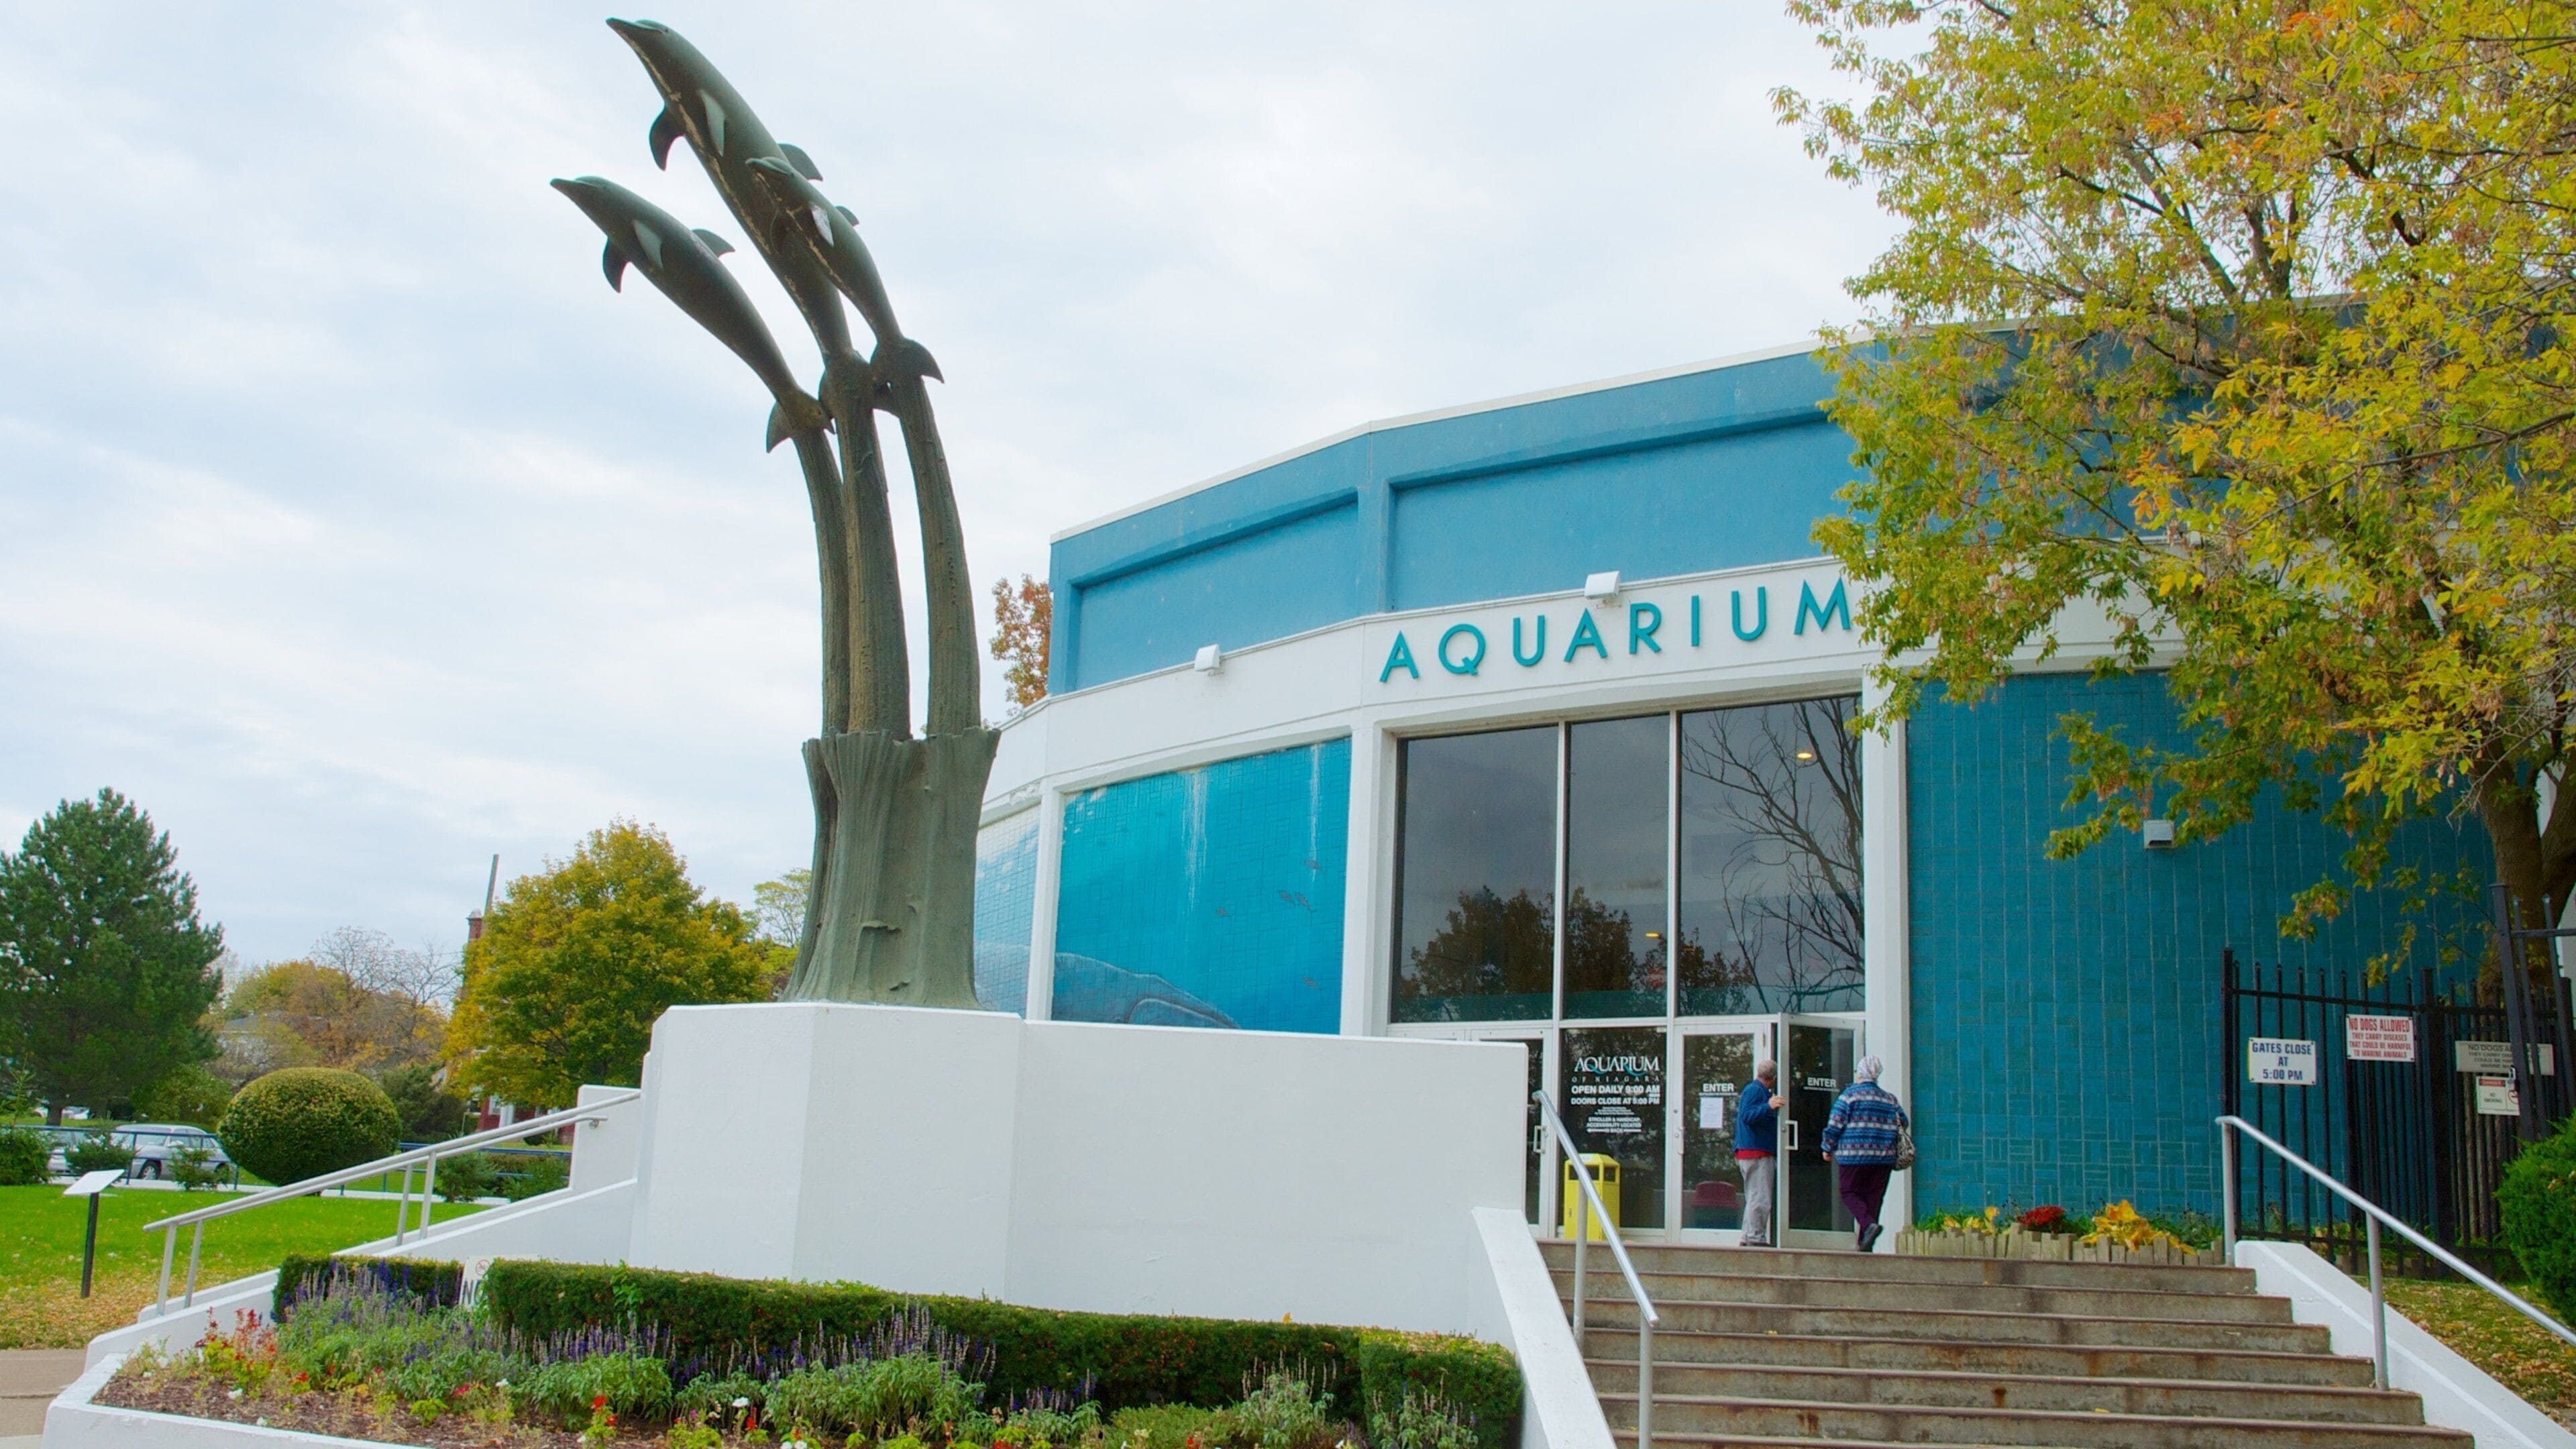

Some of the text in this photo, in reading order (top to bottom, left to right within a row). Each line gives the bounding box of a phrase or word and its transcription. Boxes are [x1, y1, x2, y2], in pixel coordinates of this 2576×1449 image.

[1379, 578, 1851, 683] AQUARIUM
[2349, 1018, 2410, 1032] NO DOGS ALLOWED
[2252, 1042, 2312, 1055] GATES CLOSE
[1574, 1056, 1660, 1075] AQUARIUM
[2278, 1056, 2288, 1067] AT
[2263, 1069, 2303, 1080] 5:00 PM
[1703, 1083, 1734, 1092] ENTER
[1807, 1077, 1837, 1087] ENTER
[1571, 1085, 1660, 1094] OPEN DAILY 9:00 AM
[1570, 1097, 1660, 1105] DOORS CLOSE AT 5:00 PM
